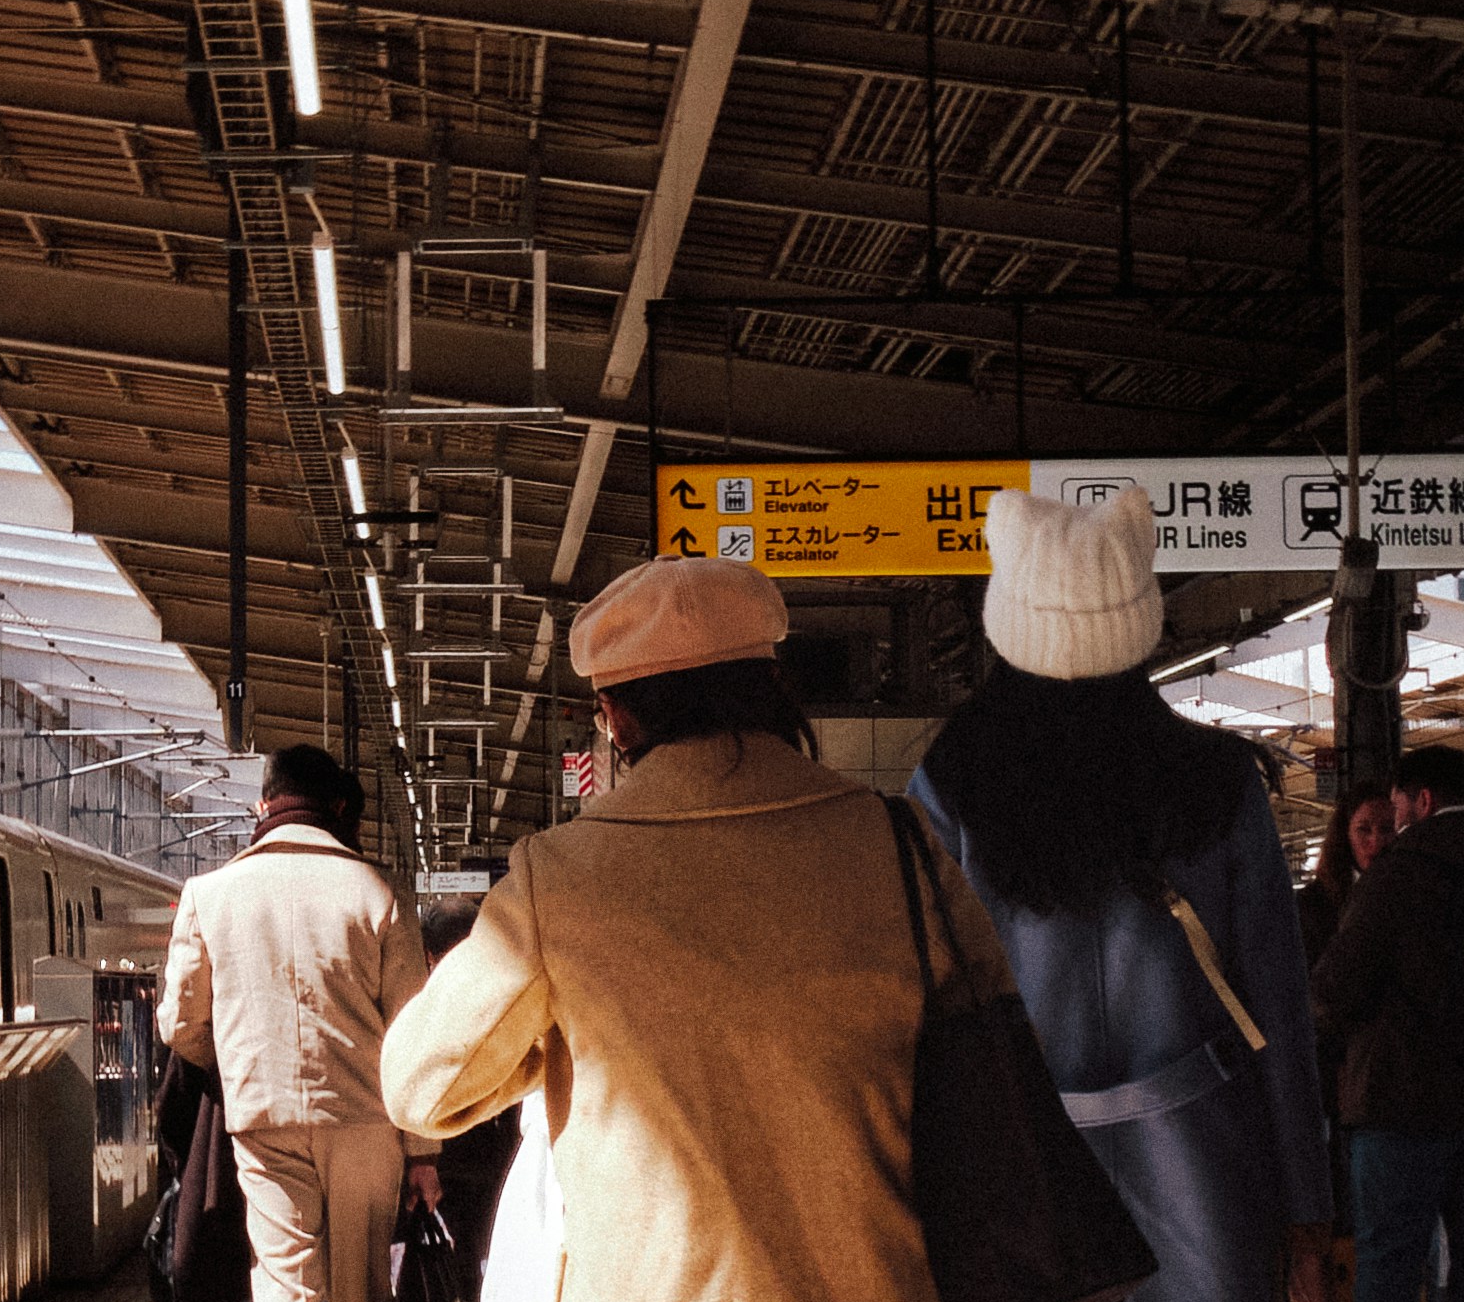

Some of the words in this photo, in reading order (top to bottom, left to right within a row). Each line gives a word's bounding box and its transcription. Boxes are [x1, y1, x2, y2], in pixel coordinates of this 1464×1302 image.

[764, 477, 881, 497] エレベーター
[764, 500, 829, 513] Elevator
[1150, 480, 1252, 518] JR線
[765, 524, 901, 545] エスカレーター
[938, 528, 989, 552] Exi
[1186, 525, 1247, 550] Lines
[1371, 522, 1453, 547] Kintetsu
[765, 548, 839, 561] Escalator
[228, 682, 243, 698] 11
